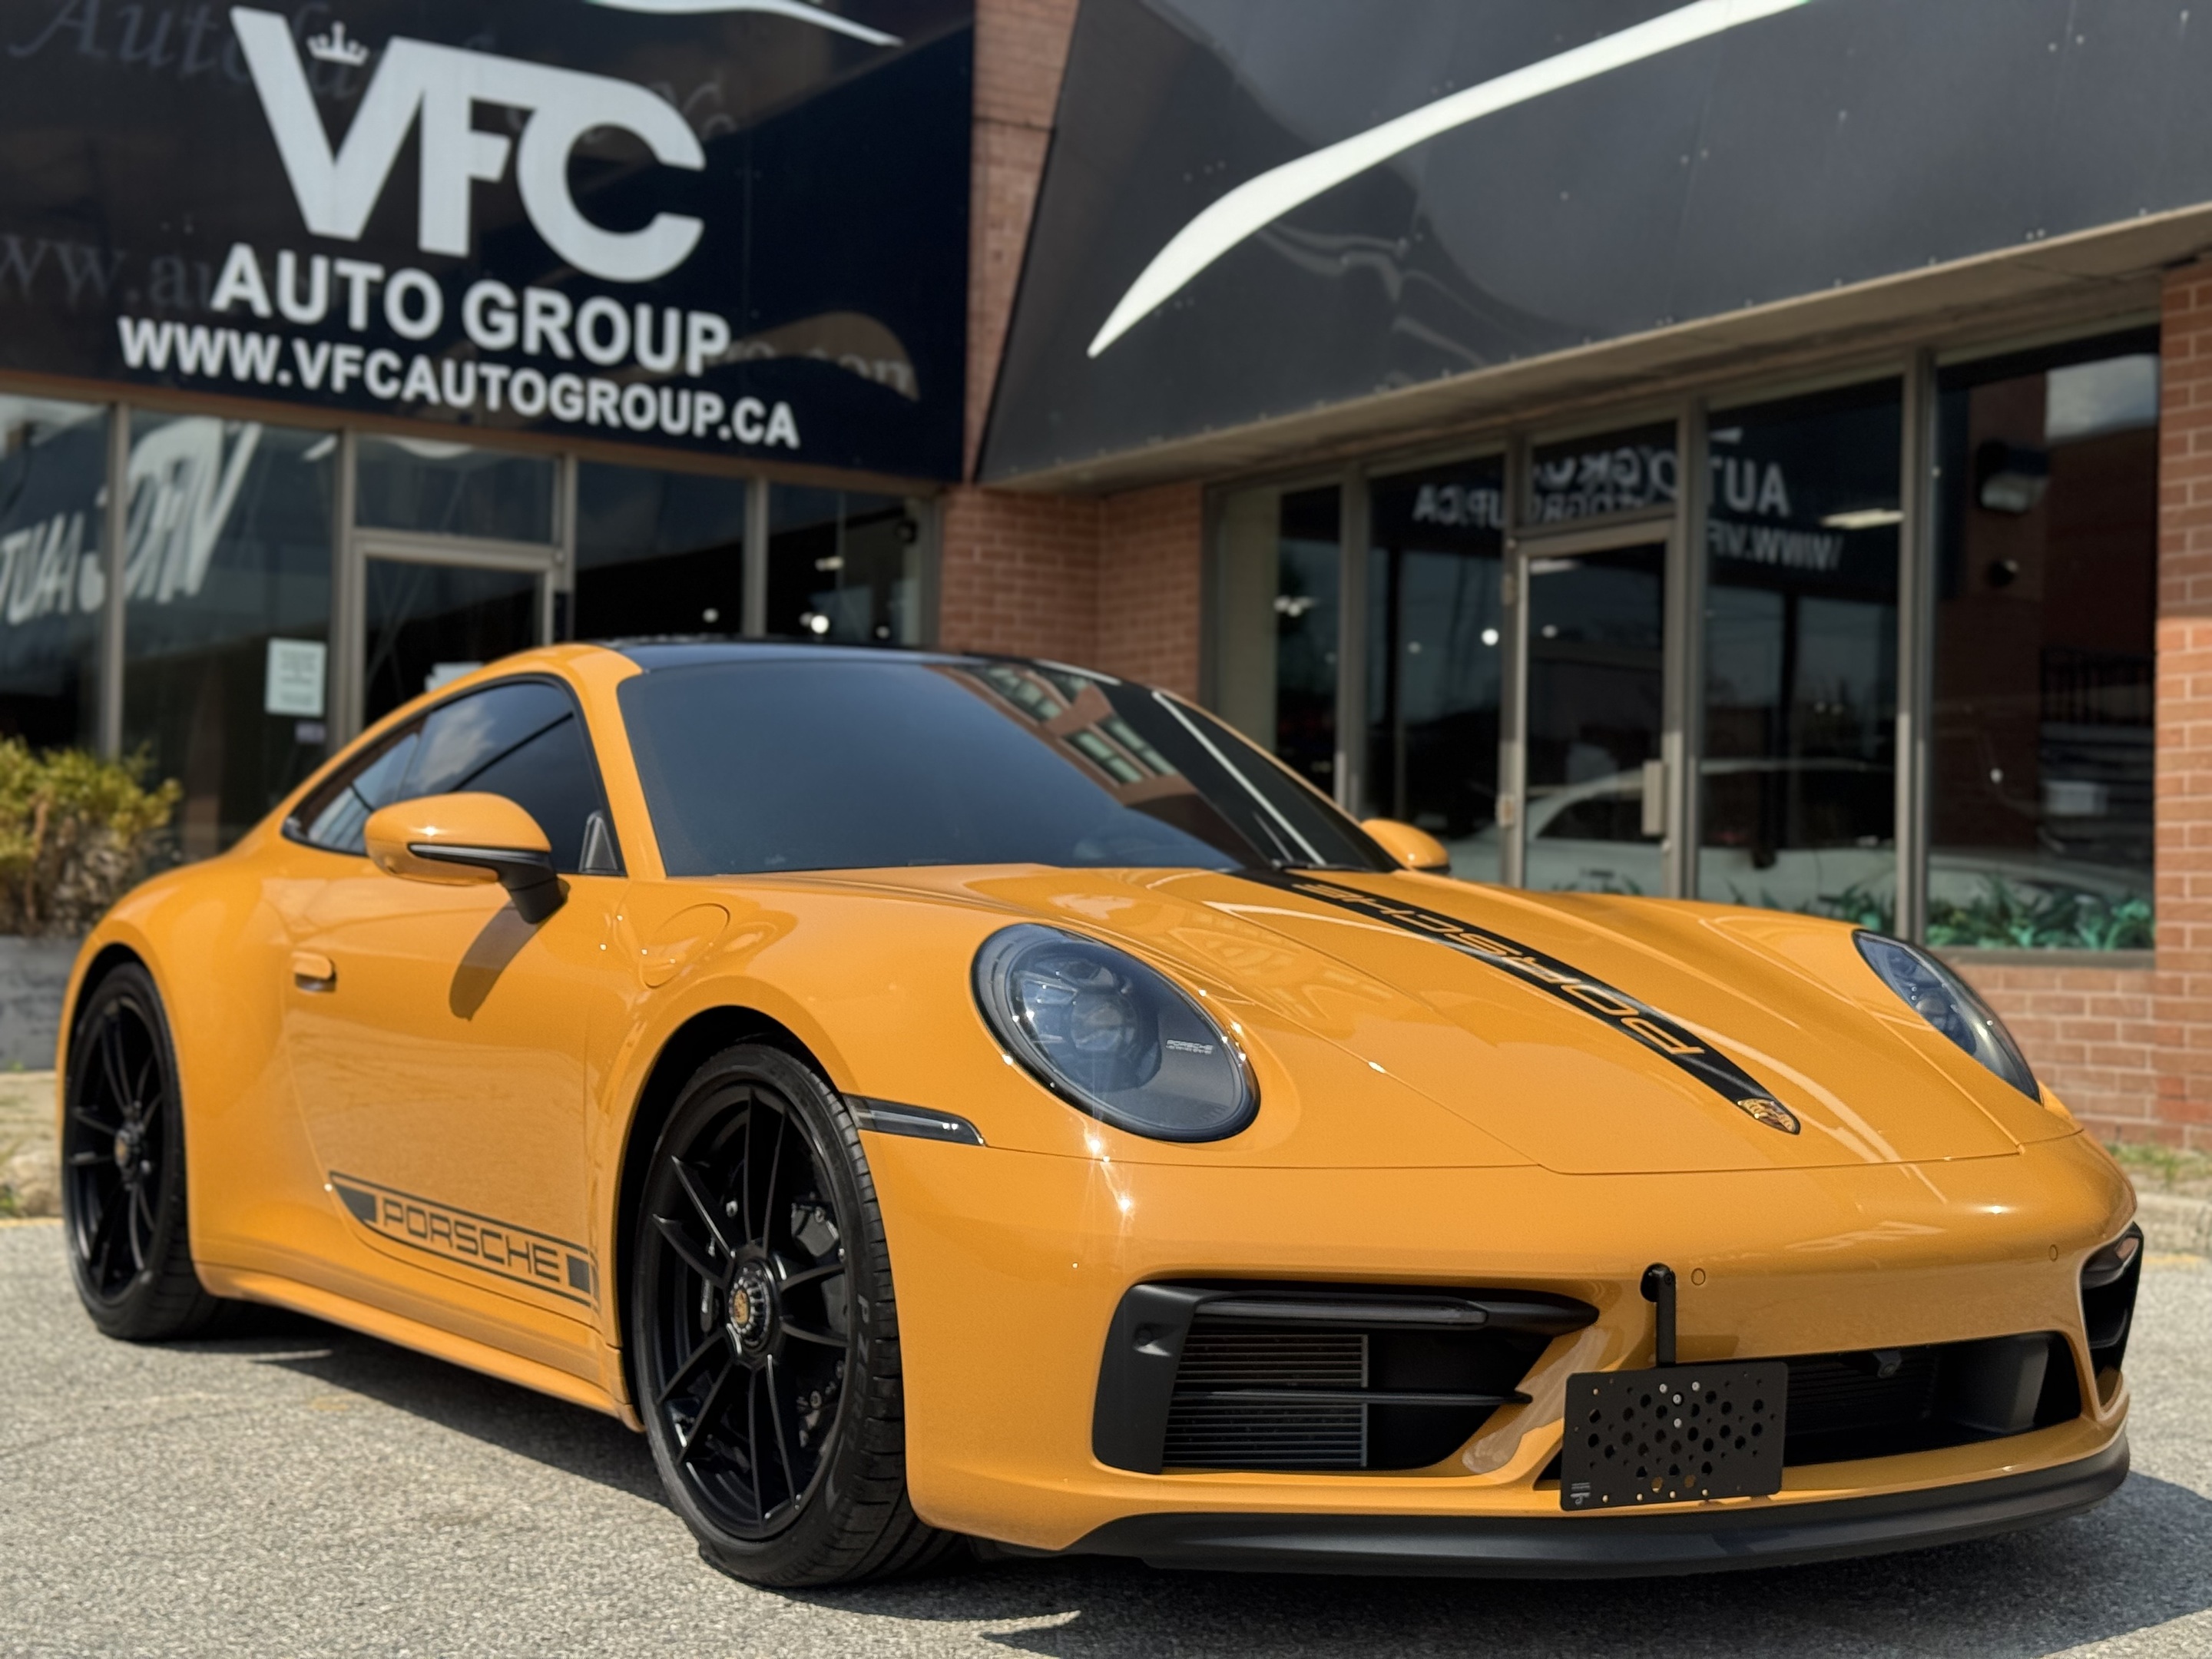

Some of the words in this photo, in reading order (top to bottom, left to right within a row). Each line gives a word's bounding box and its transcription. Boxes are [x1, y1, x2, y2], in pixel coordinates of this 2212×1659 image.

[231, 6, 705, 283] VFC
[210, 243, 444, 339] AUTO
[462, 280, 730, 376] GROUP
[118, 316, 800, 449] WWW.VFCAUTOGROUP.CA
[1292, 884, 1705, 1055] PORSCHE
[382, 1196, 561, 1283] PORSCHE
